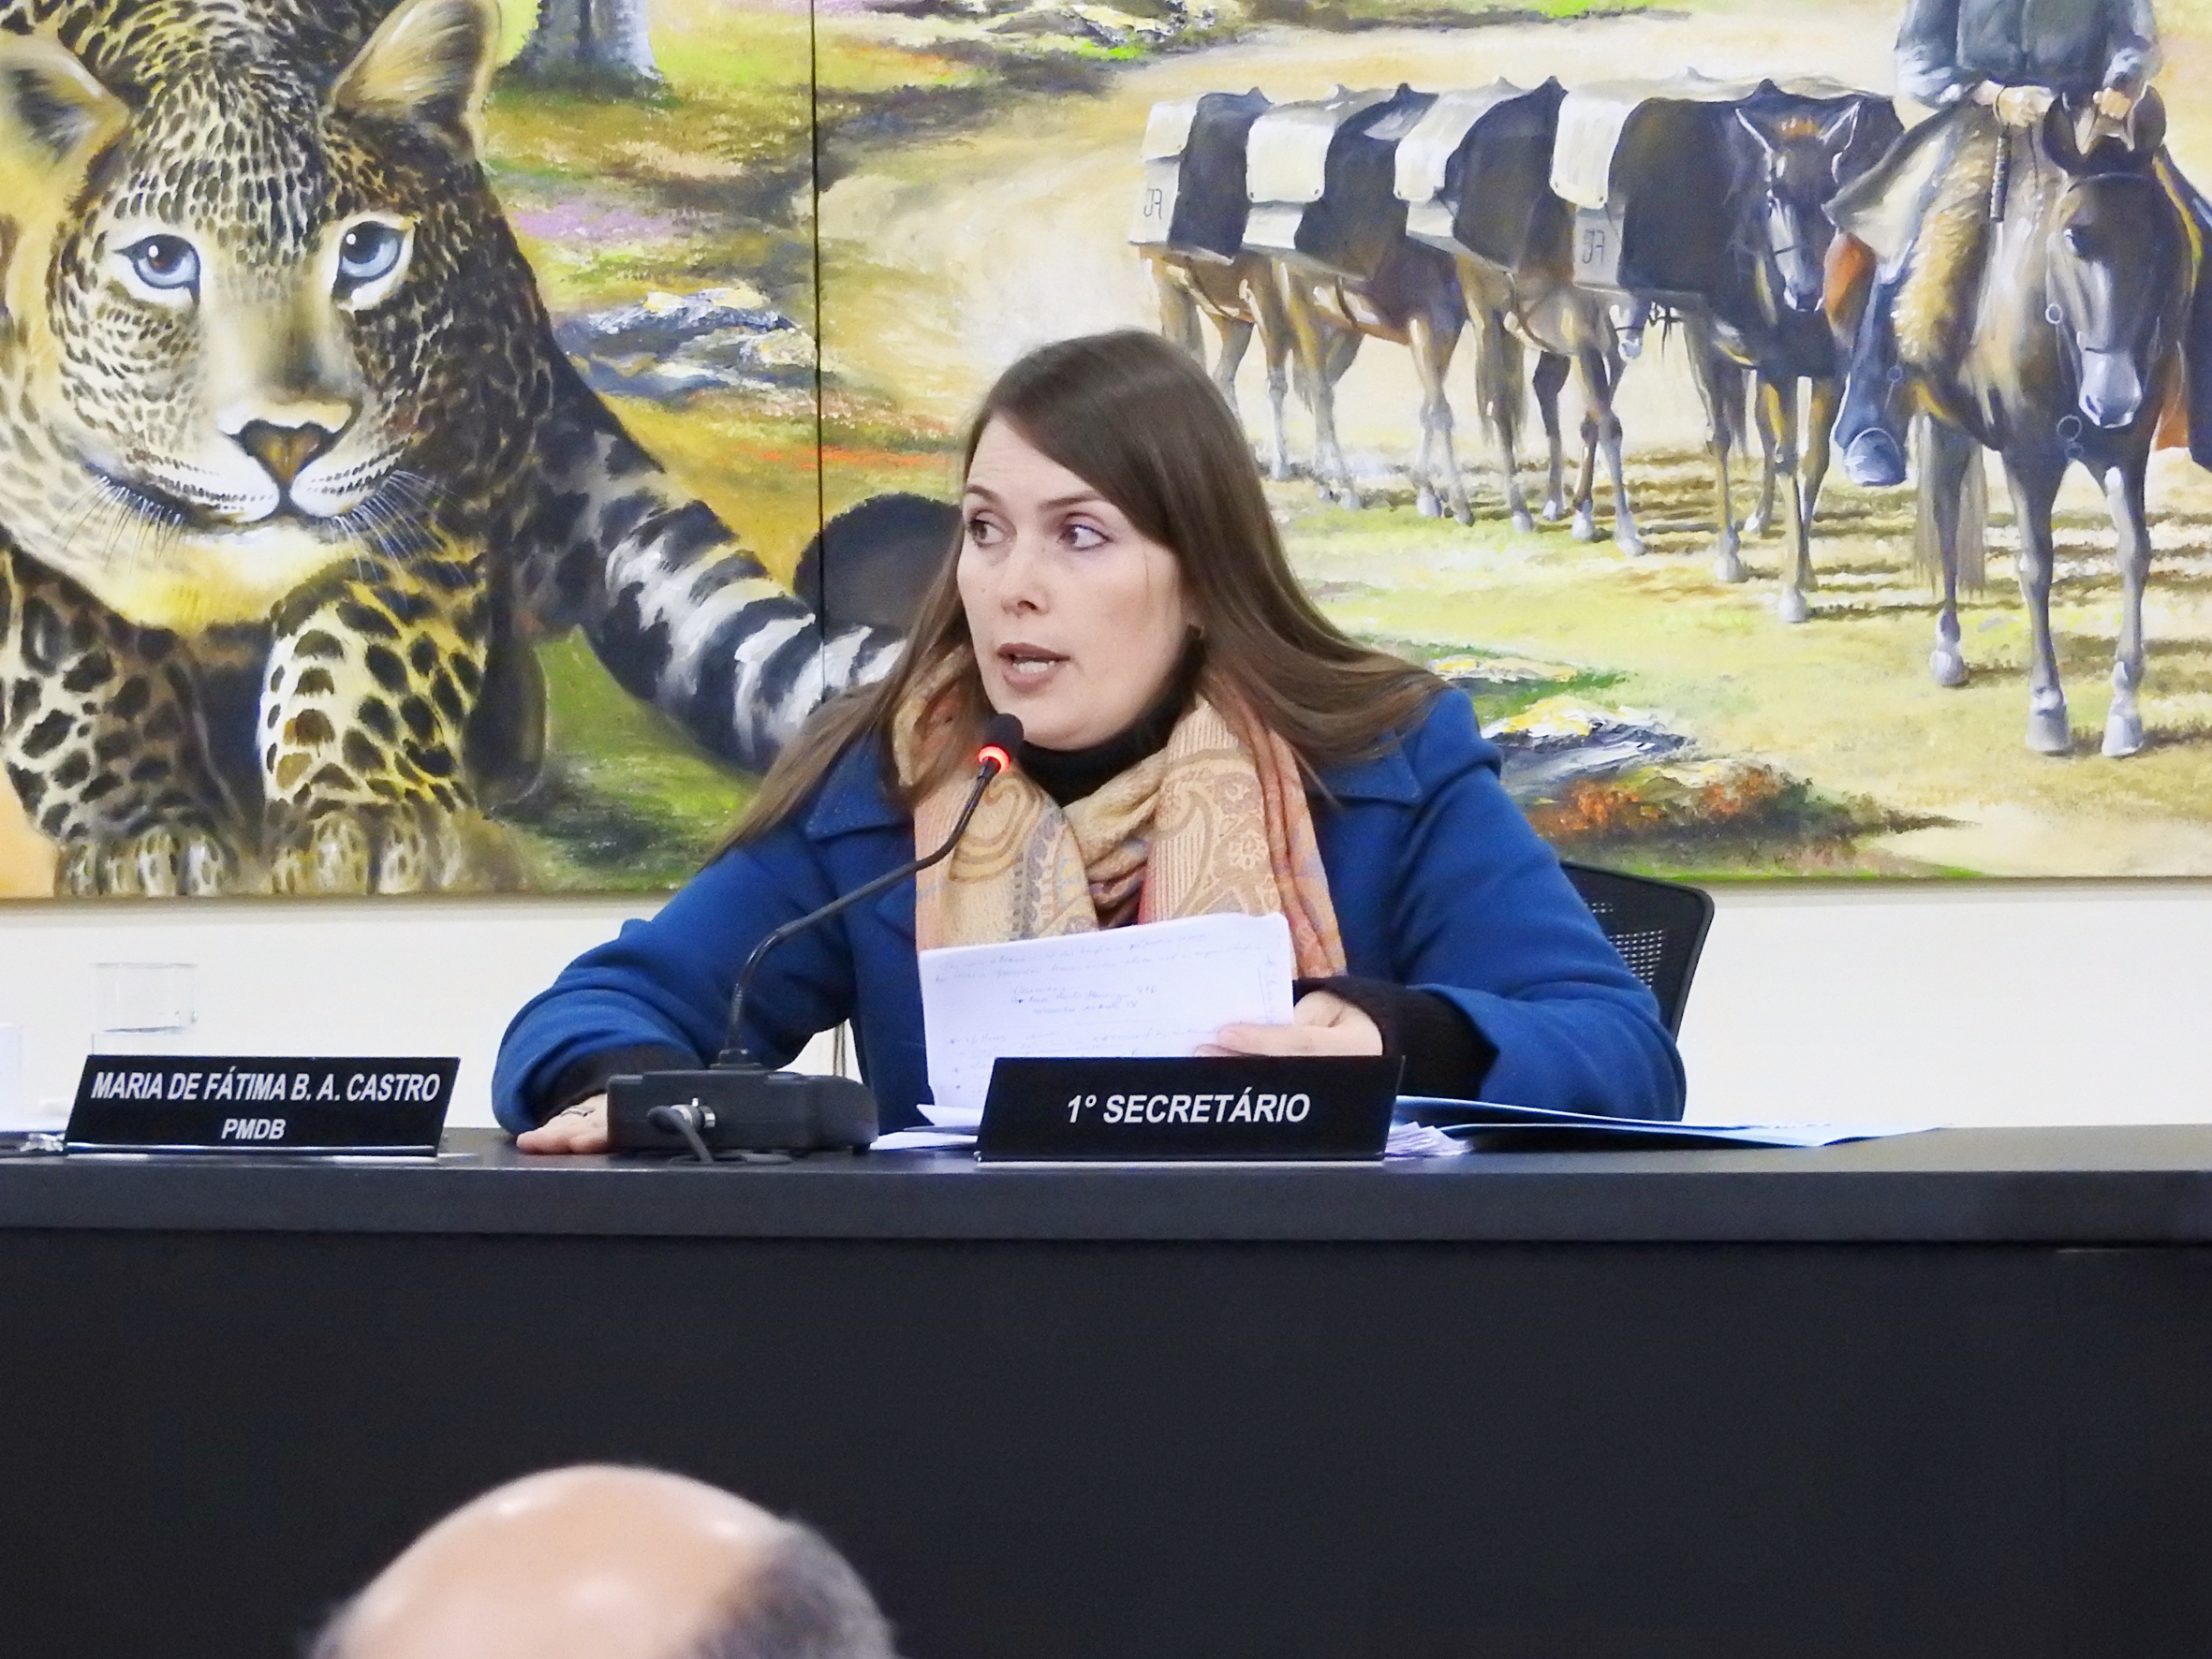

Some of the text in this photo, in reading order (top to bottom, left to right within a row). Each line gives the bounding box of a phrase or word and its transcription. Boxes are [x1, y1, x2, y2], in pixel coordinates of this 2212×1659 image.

[91, 1065, 441, 1102] MARIA DE FÁTIMA B. A. CASTRO
[1103, 1086, 1311, 1123] SECRETÁRIO
[221, 1118, 287, 1140] PMDB
